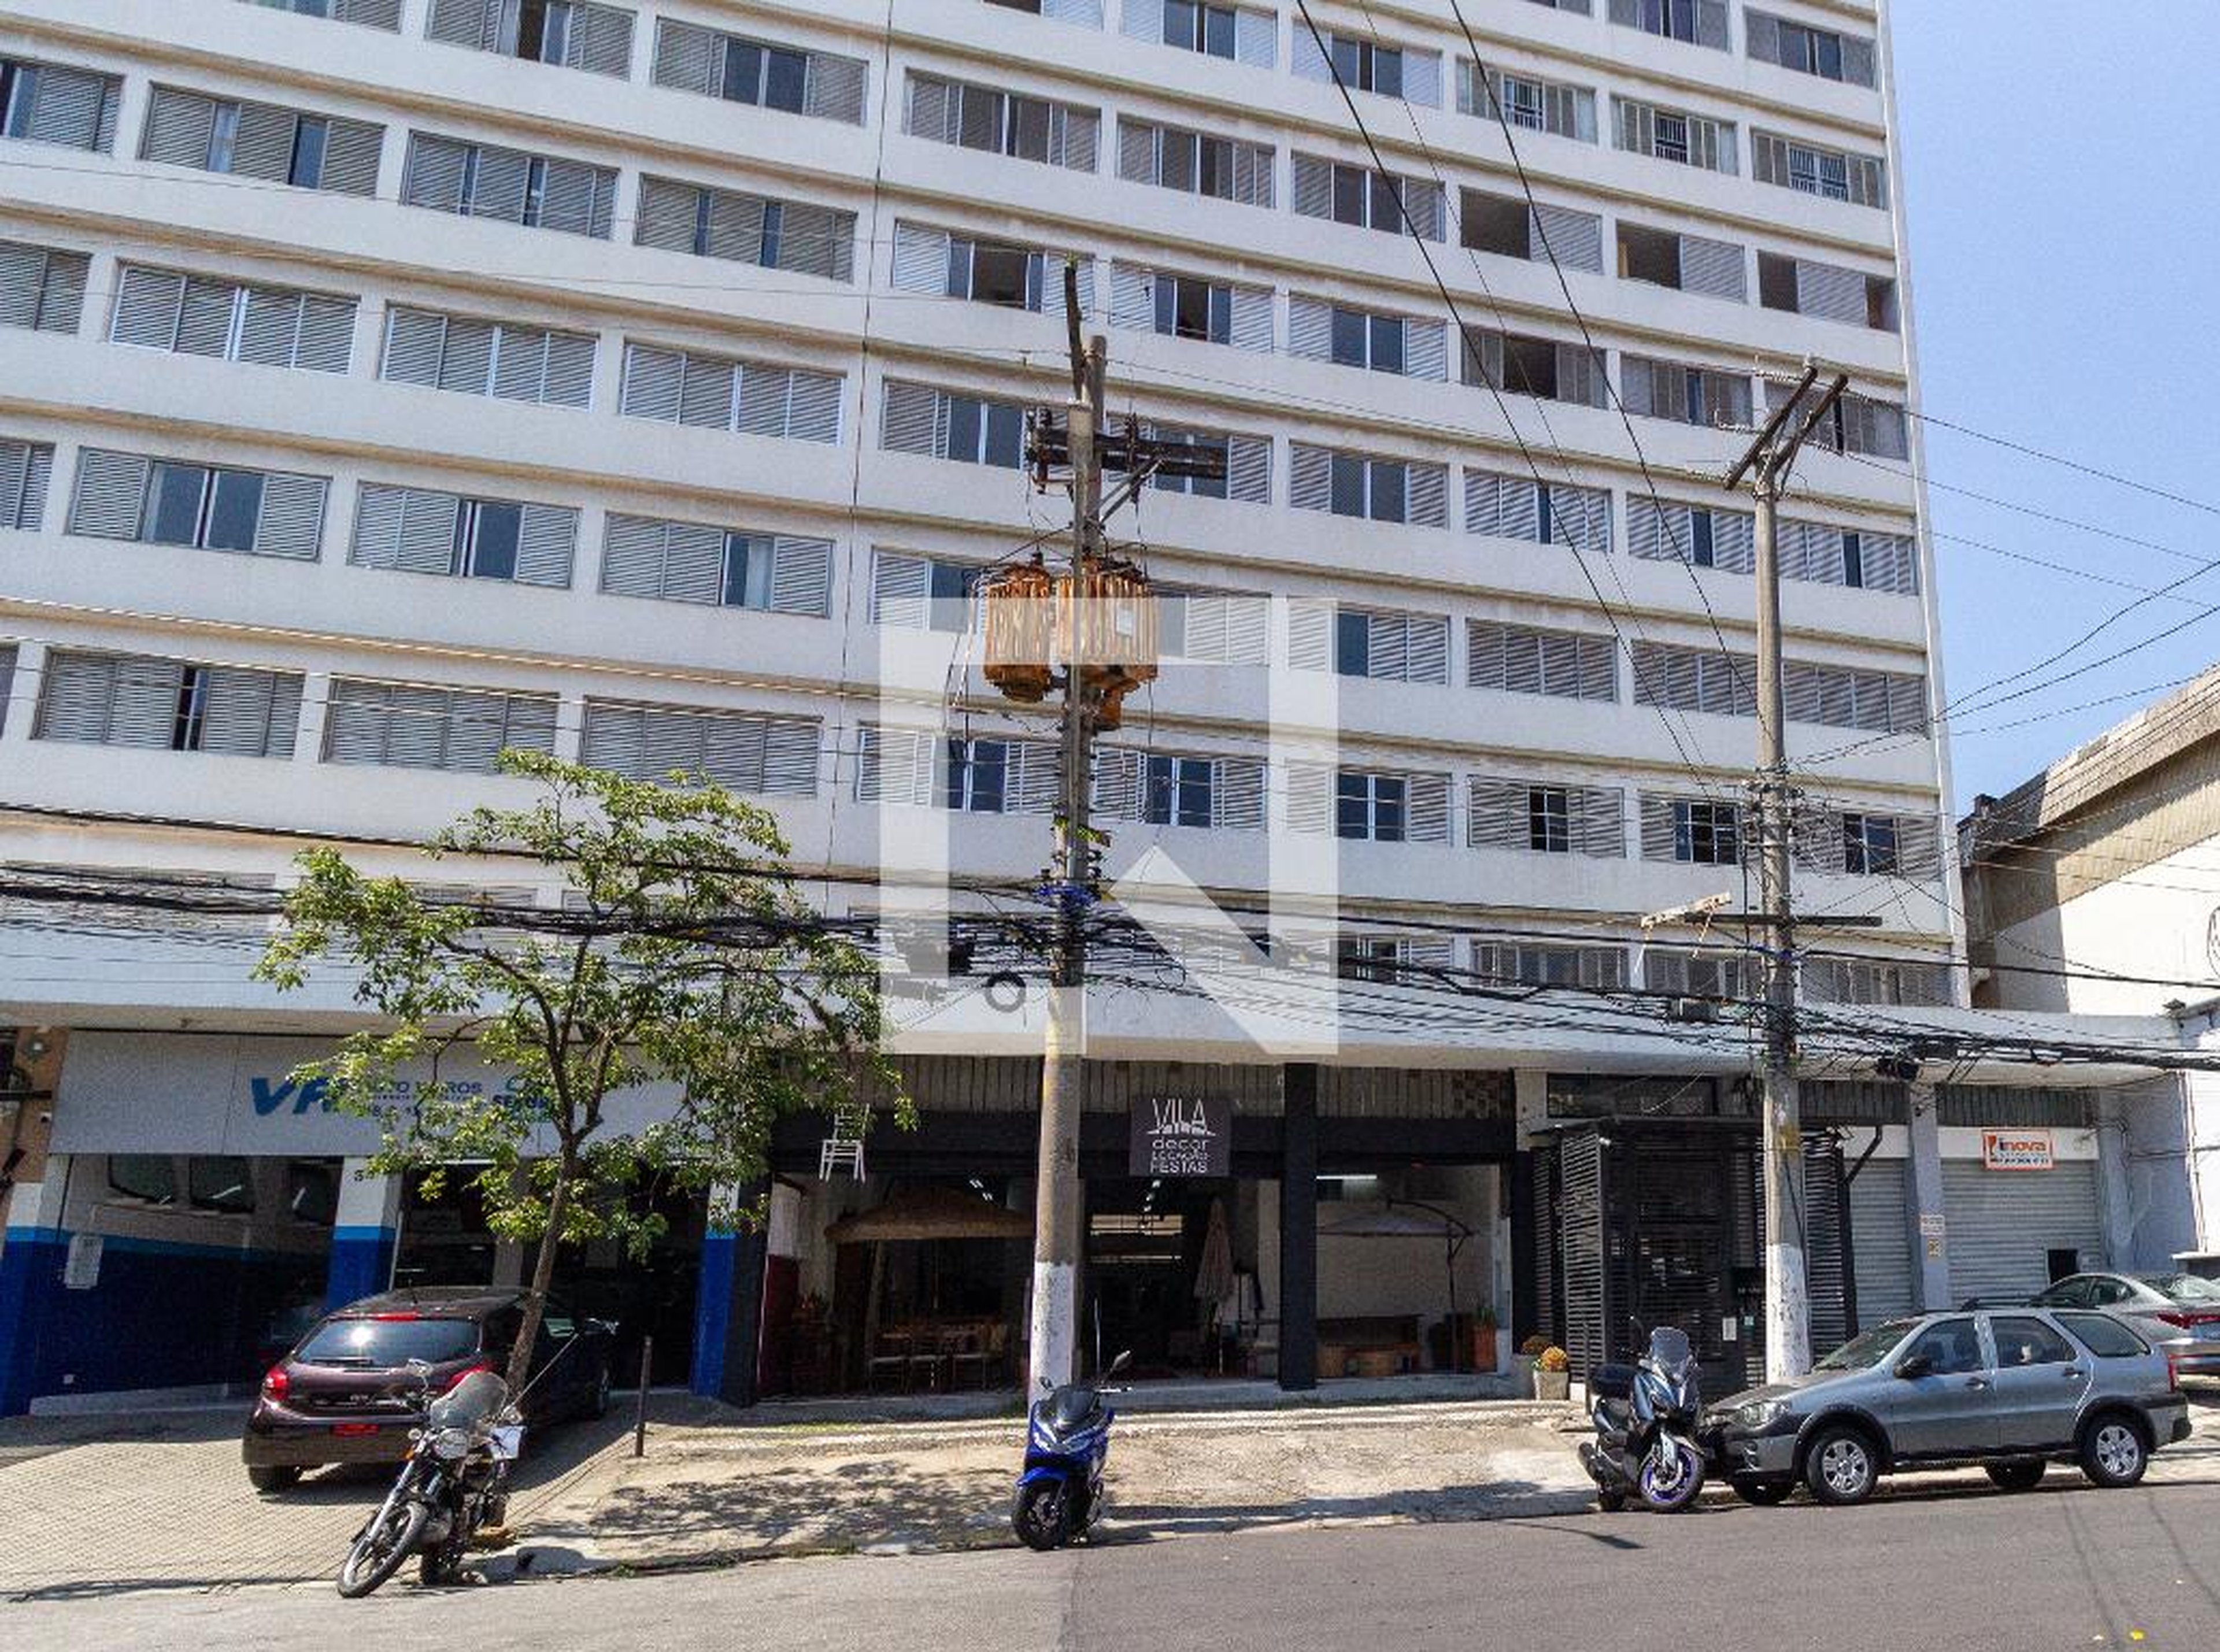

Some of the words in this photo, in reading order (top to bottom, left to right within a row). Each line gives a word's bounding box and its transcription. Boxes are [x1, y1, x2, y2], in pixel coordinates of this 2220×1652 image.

[1152, 1098, 1207, 1134] VILA
[1152, 1137, 1209, 1150] decor
[1150, 1161, 1207, 1173] FESTAS
